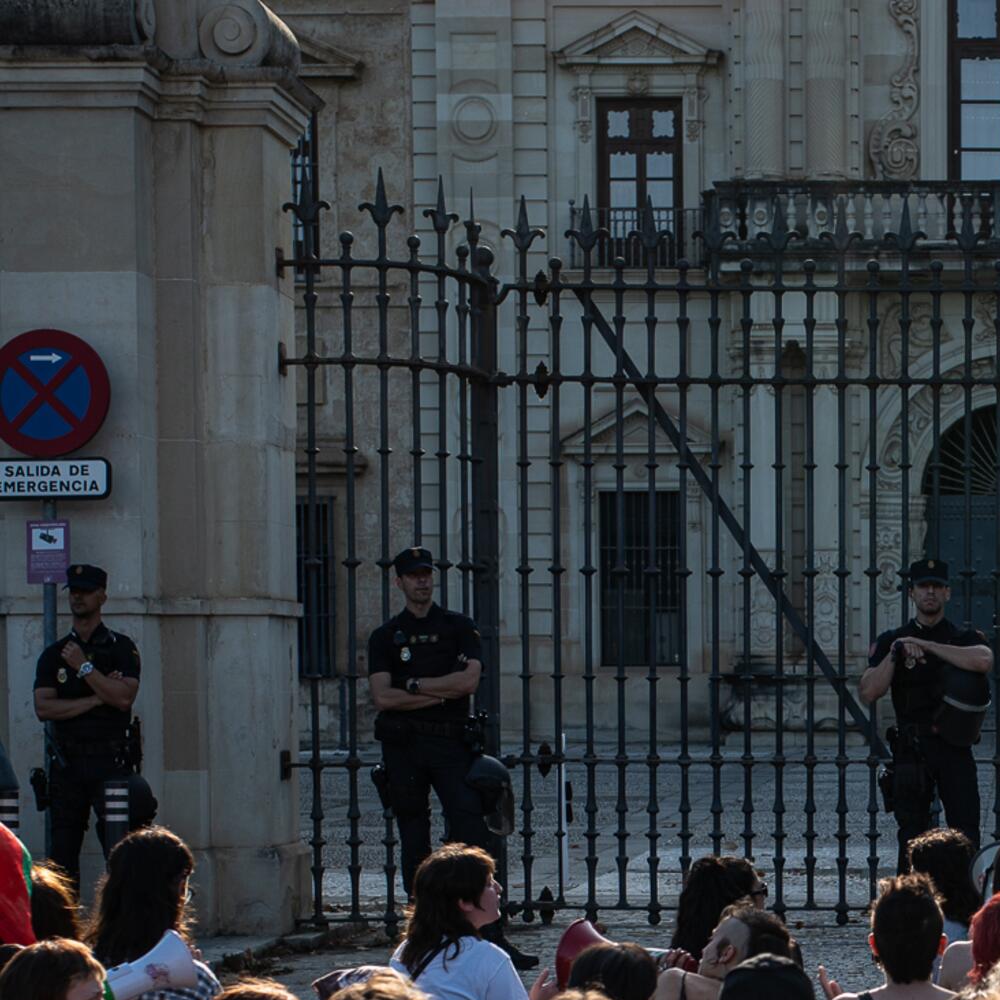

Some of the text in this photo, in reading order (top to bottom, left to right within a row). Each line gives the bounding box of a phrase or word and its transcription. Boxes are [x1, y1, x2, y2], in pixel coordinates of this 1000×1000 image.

[4, 464, 89, 477] SALIDA DE
[0, 480, 99, 493] MERGENCIA
